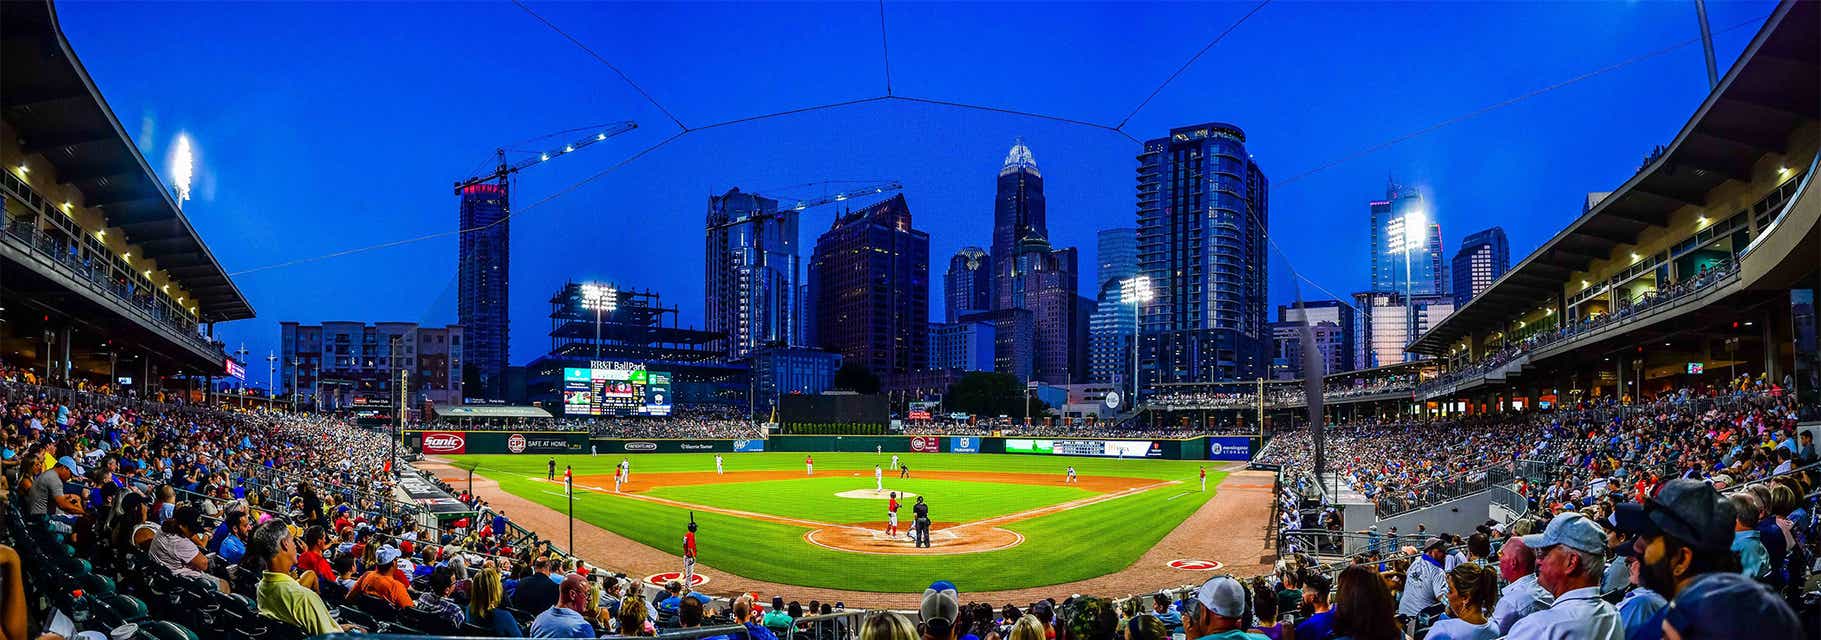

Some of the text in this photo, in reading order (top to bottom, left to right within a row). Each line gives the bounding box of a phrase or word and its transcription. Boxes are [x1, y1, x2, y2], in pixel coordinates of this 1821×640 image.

[614, 361, 646, 371] BallPark
[423, 436, 458, 446] Sonic
[527, 440, 542, 448] SAFE
[542, 440, 550, 448] AT
[550, 440, 567, 448] HOME
